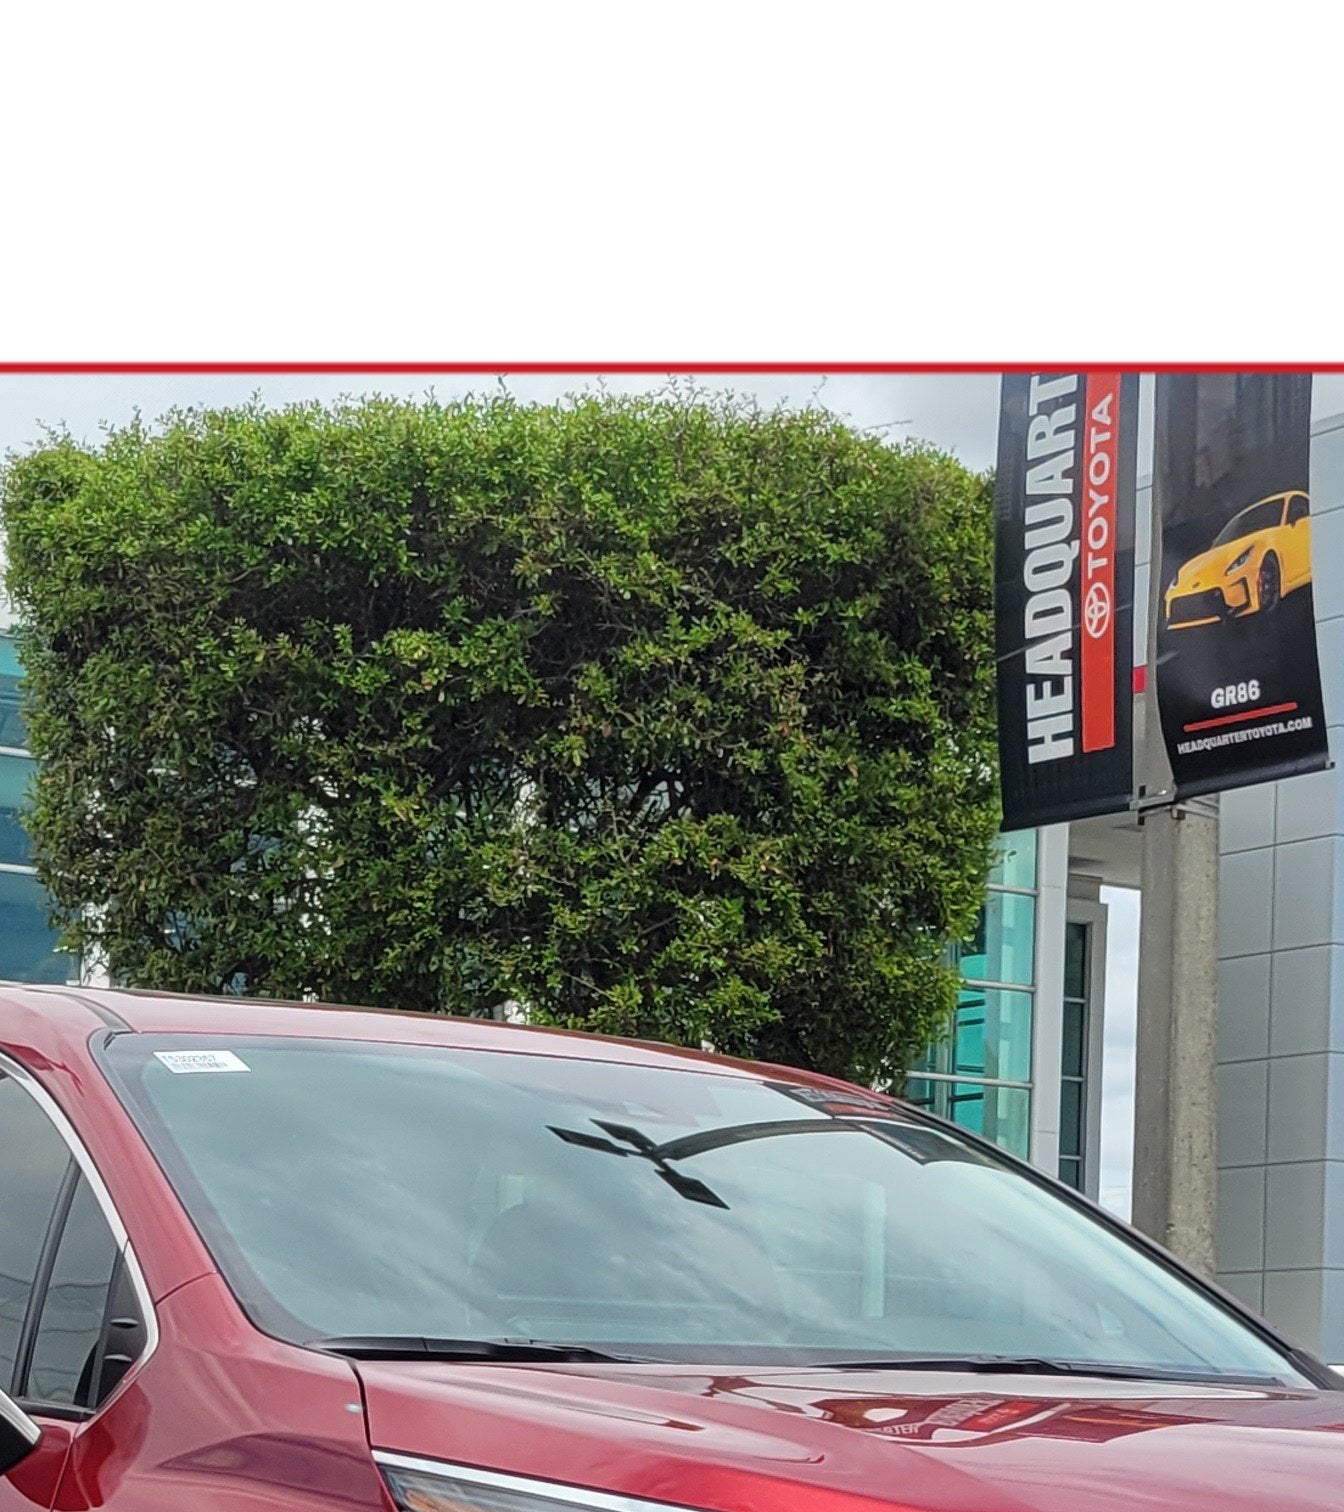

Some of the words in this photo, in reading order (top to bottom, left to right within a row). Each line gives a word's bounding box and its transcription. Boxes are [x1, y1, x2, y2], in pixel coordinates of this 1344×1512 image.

[1088, 392, 1114, 580] TOYOTA
[1024, 373, 1079, 764] HEADQUART
[1176, 716, 1313, 755] HEADQUARTERTOYOTA.COM
[1210, 679, 1261, 709] GR86
